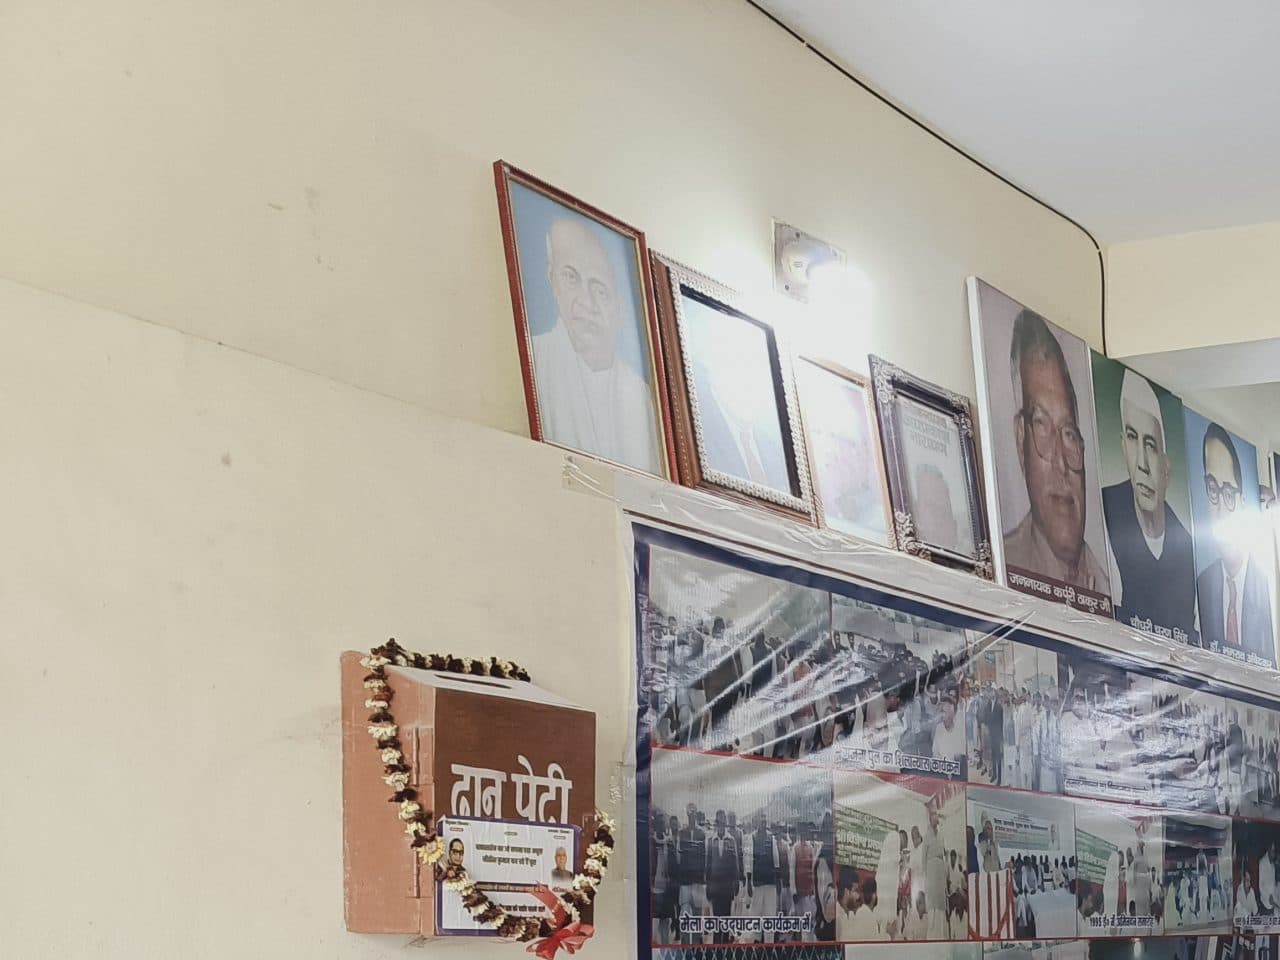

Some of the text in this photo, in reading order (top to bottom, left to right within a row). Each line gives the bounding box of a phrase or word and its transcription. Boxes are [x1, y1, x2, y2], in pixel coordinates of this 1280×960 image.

[1008, 572, 1111, 613] जननायक कर्पूरी ठाकुर जी
[451, 754, 572, 825] दान पेटी
[680, 912, 701, 932] मेला
[703, 916, 719, 933] का
[763, 912, 800, 932] कार्यक्रम
[801, 911, 812, 932] में
